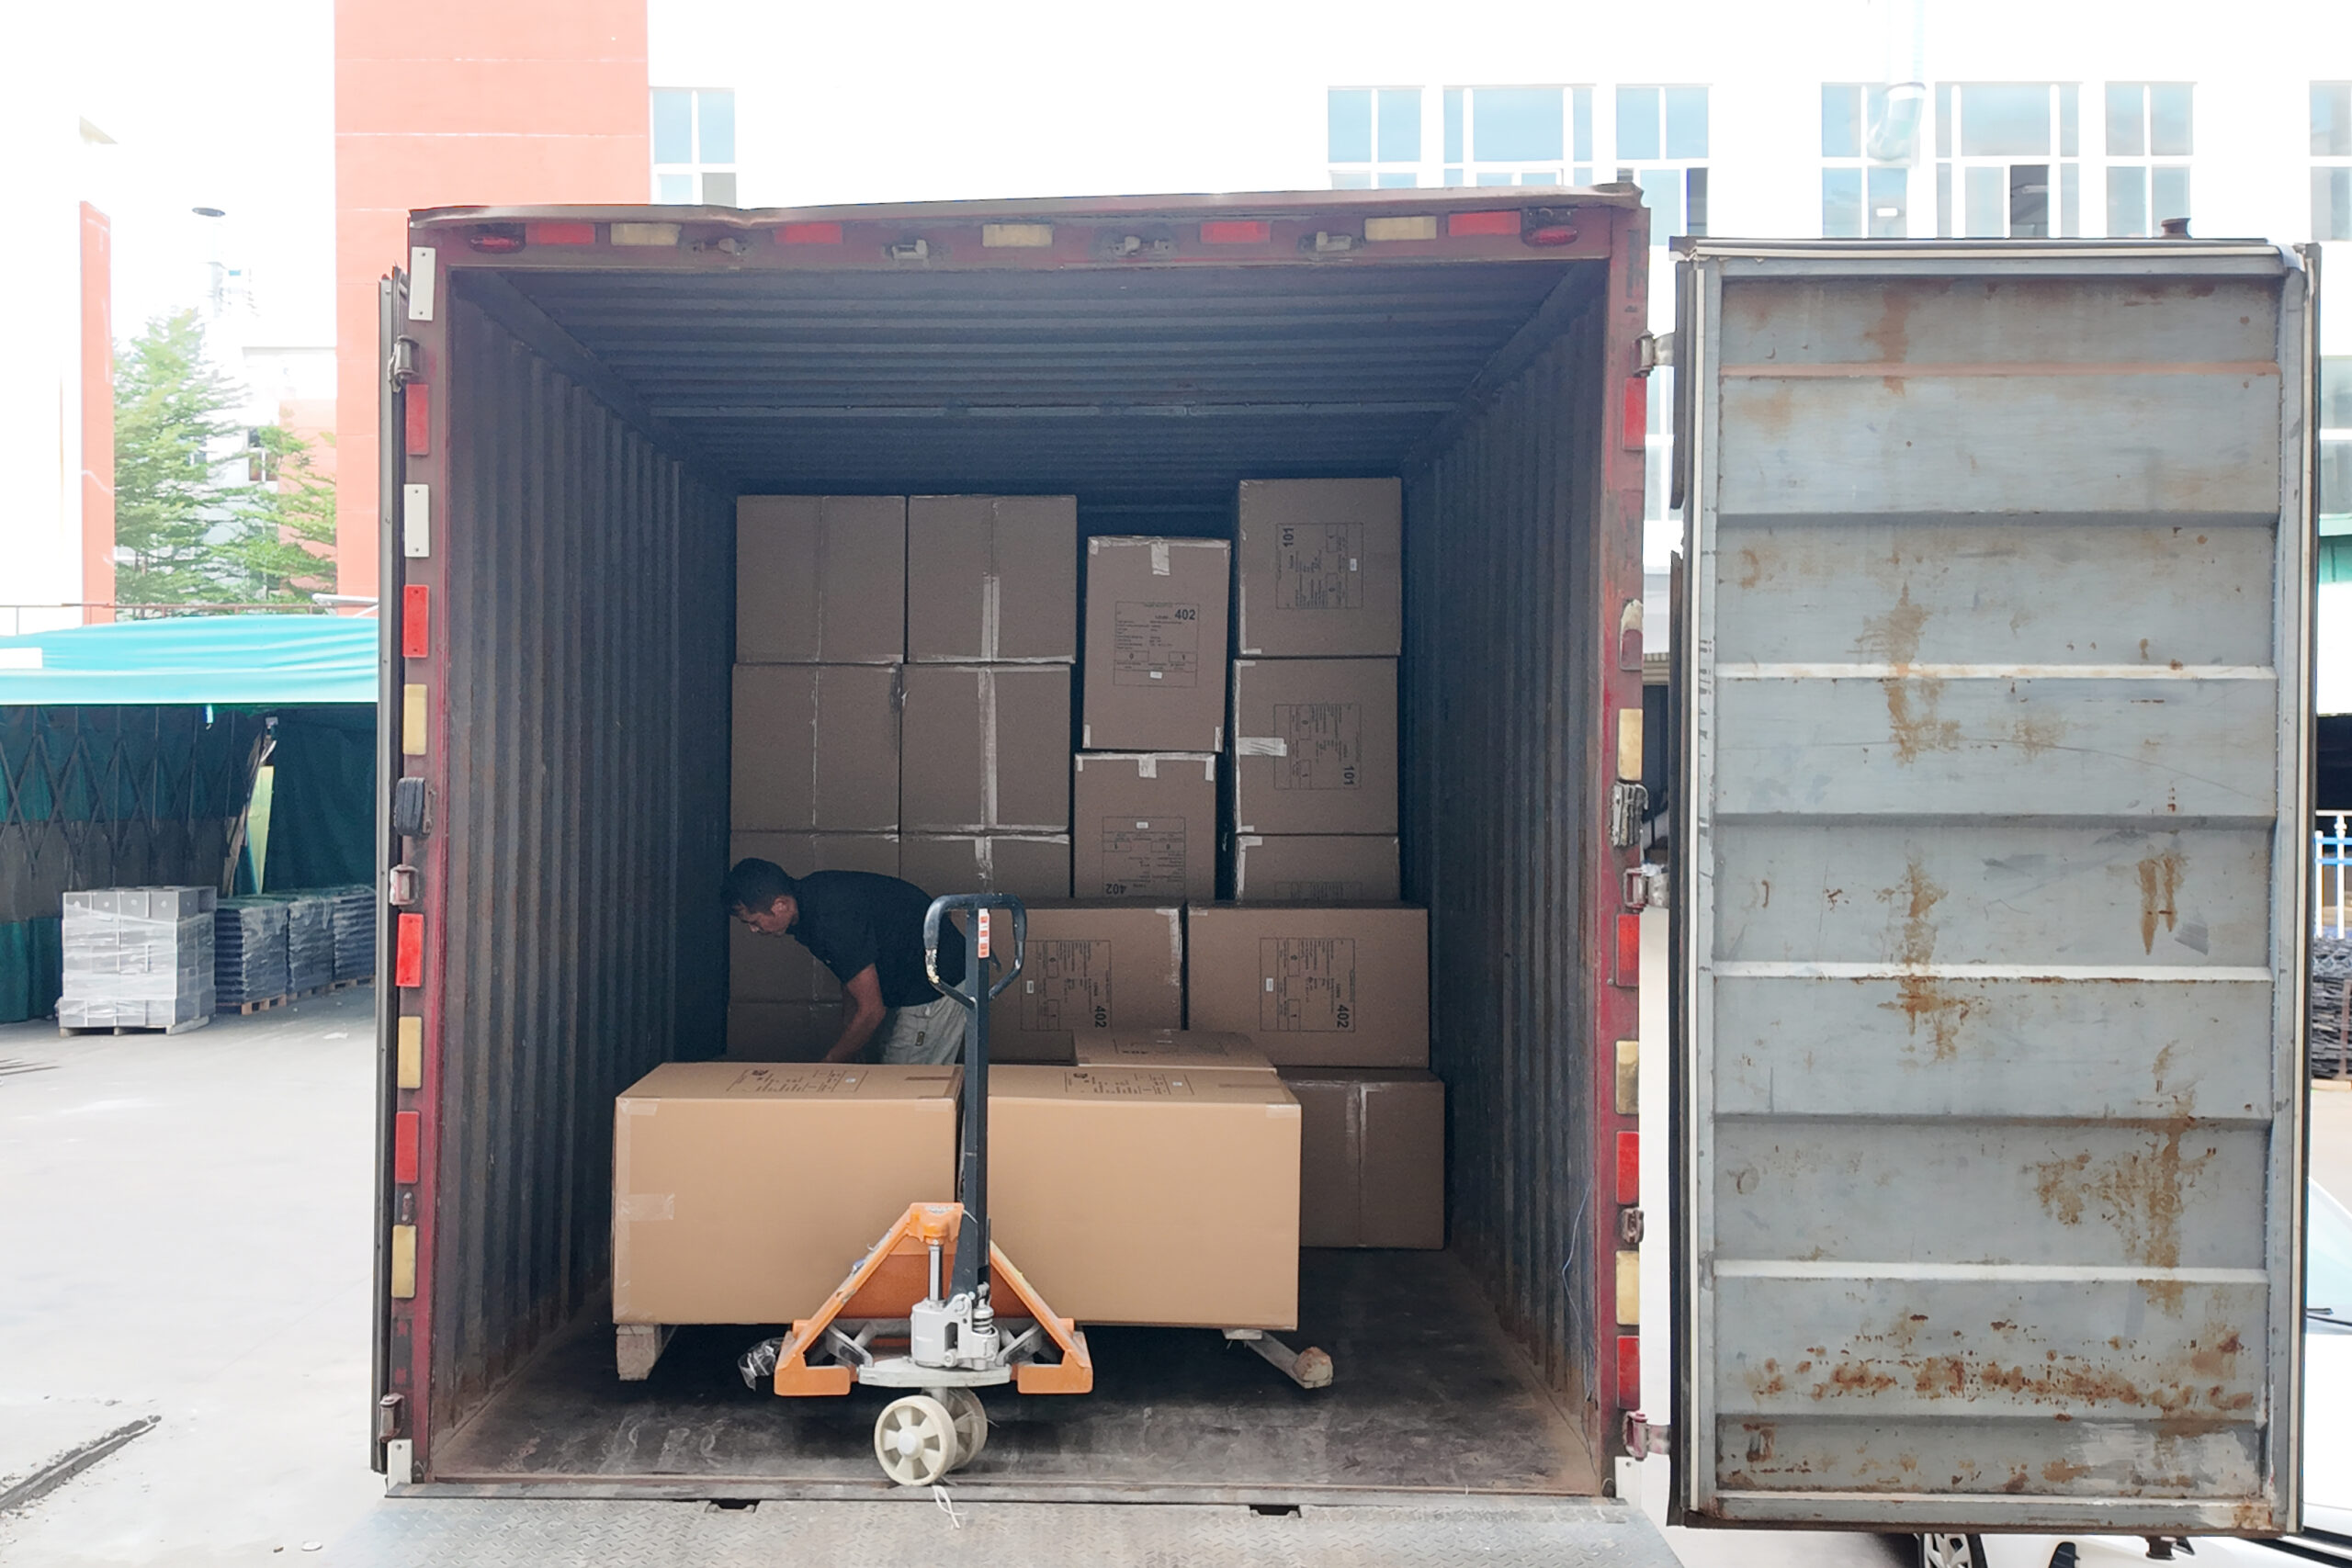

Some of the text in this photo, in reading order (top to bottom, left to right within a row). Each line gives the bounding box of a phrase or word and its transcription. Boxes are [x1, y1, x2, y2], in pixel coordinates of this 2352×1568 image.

[1283, 527, 1295, 548] 101
[1174, 609, 1196, 621] 402
[1343, 765, 1355, 785] 101
[1105, 883, 1126, 895] 402
[1094, 1005, 1107, 1028] 402
[1337, 1004, 1350, 1029] 402
